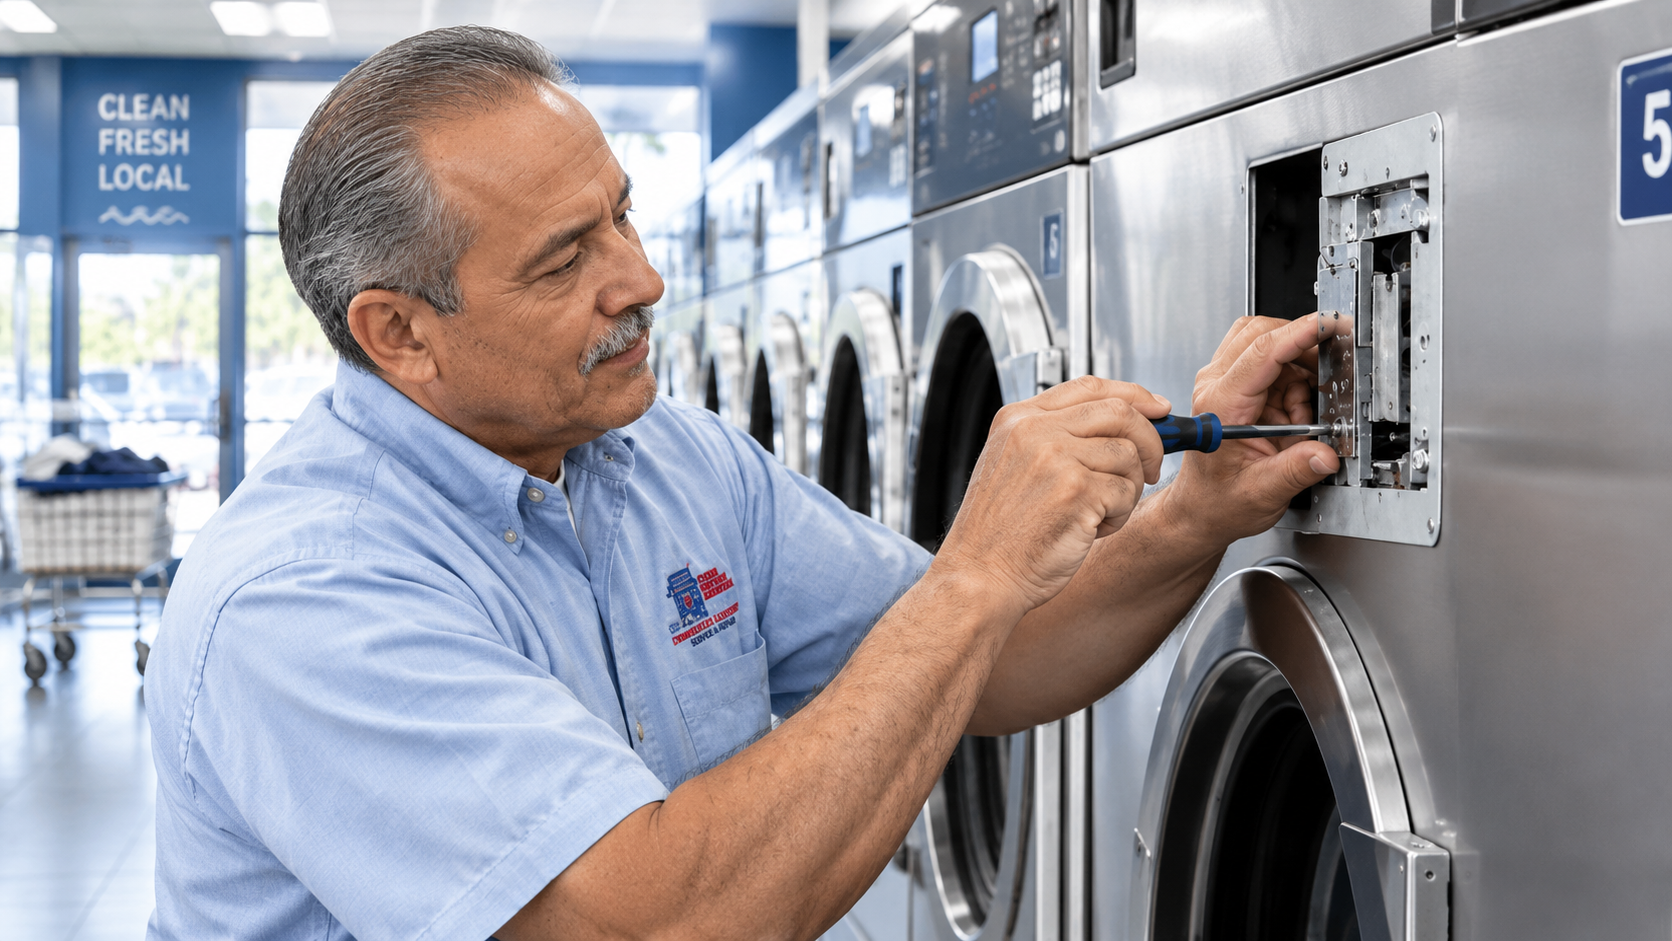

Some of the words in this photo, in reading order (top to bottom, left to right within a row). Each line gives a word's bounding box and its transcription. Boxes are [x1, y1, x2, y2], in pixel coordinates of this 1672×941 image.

[98, 93, 190, 121] CLEAN
[98, 128, 190, 156] FRESH
[1642, 89, 1672, 179] 5
[98, 163, 191, 191] LOCAL
